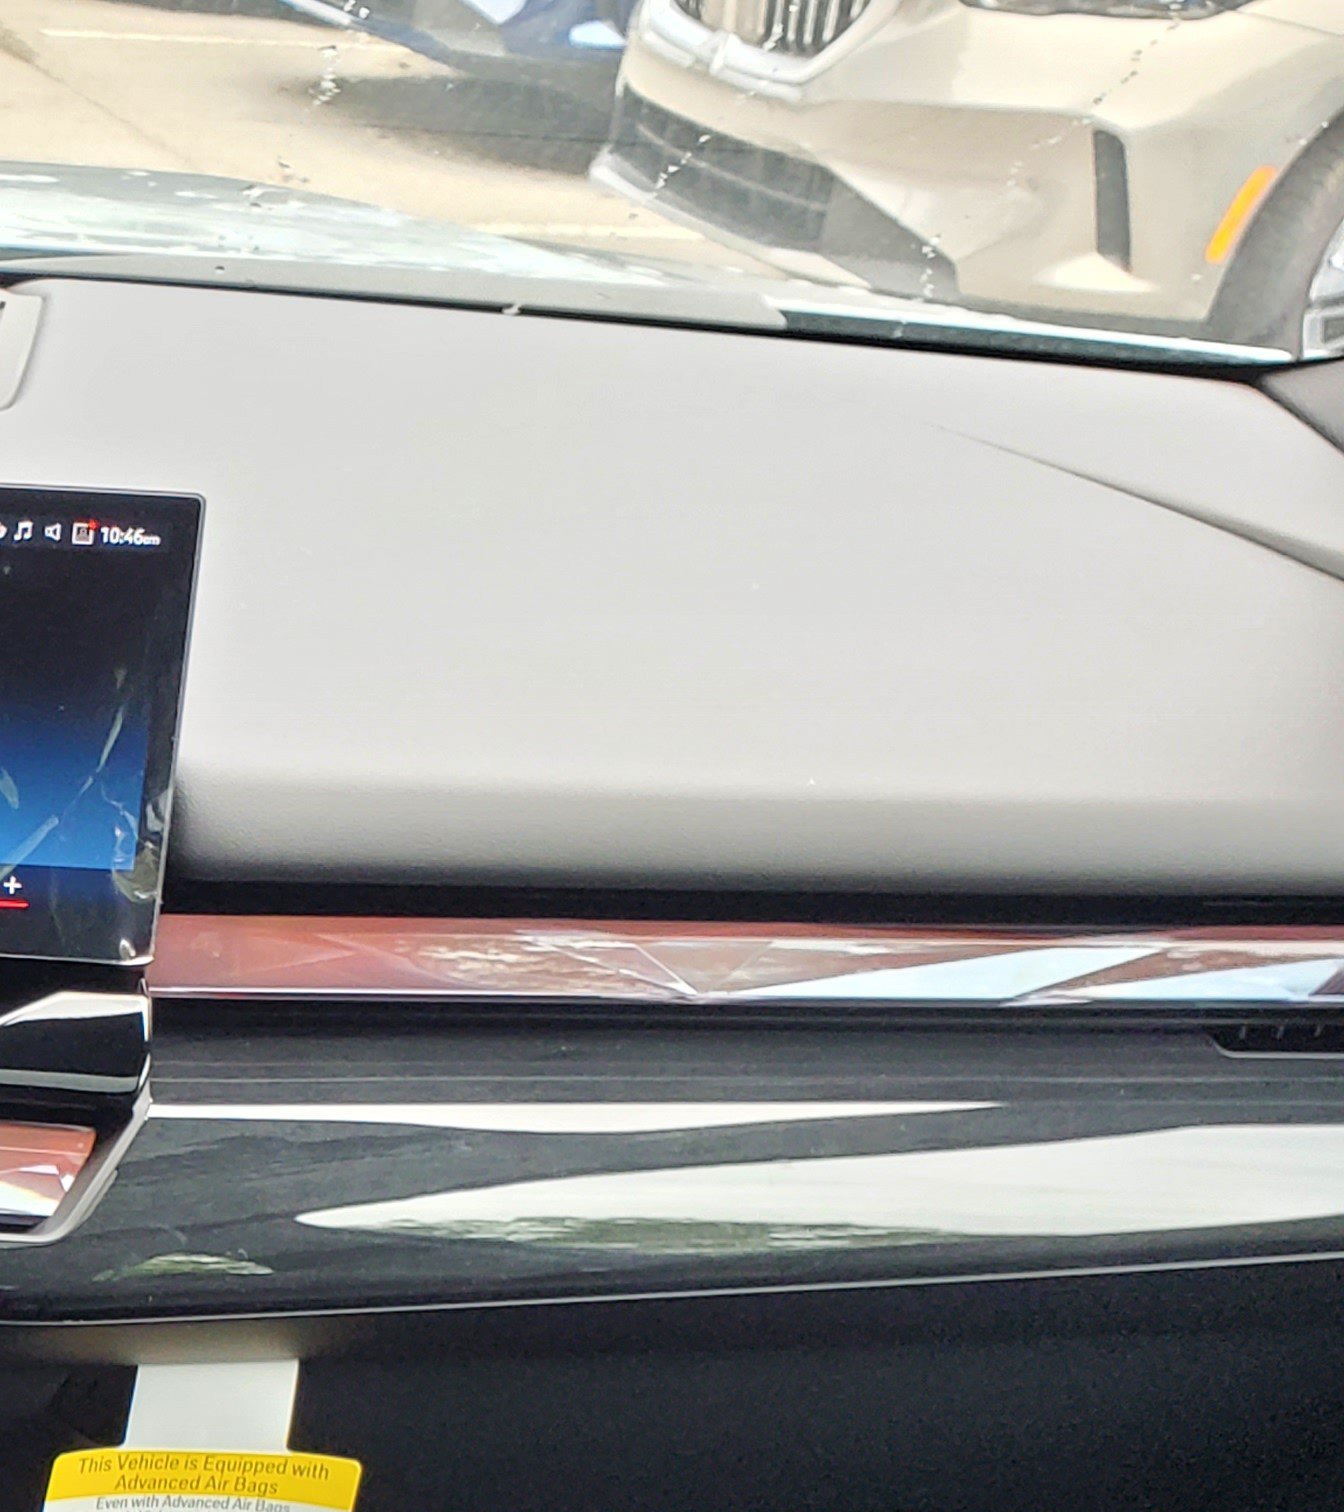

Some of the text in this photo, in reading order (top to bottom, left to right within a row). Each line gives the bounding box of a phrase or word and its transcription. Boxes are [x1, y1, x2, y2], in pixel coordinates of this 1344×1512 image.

[78, 1454, 330, 1480] This Vehicle is Equipped with
[114, 1474, 279, 1498] Advanced Air Bags
[96, 1496, 129, 1511] Even
[130, 1494, 160, 1509] with
[162, 1494, 230, 1510] Advanced
[231, 1497, 252, 1511] Air
